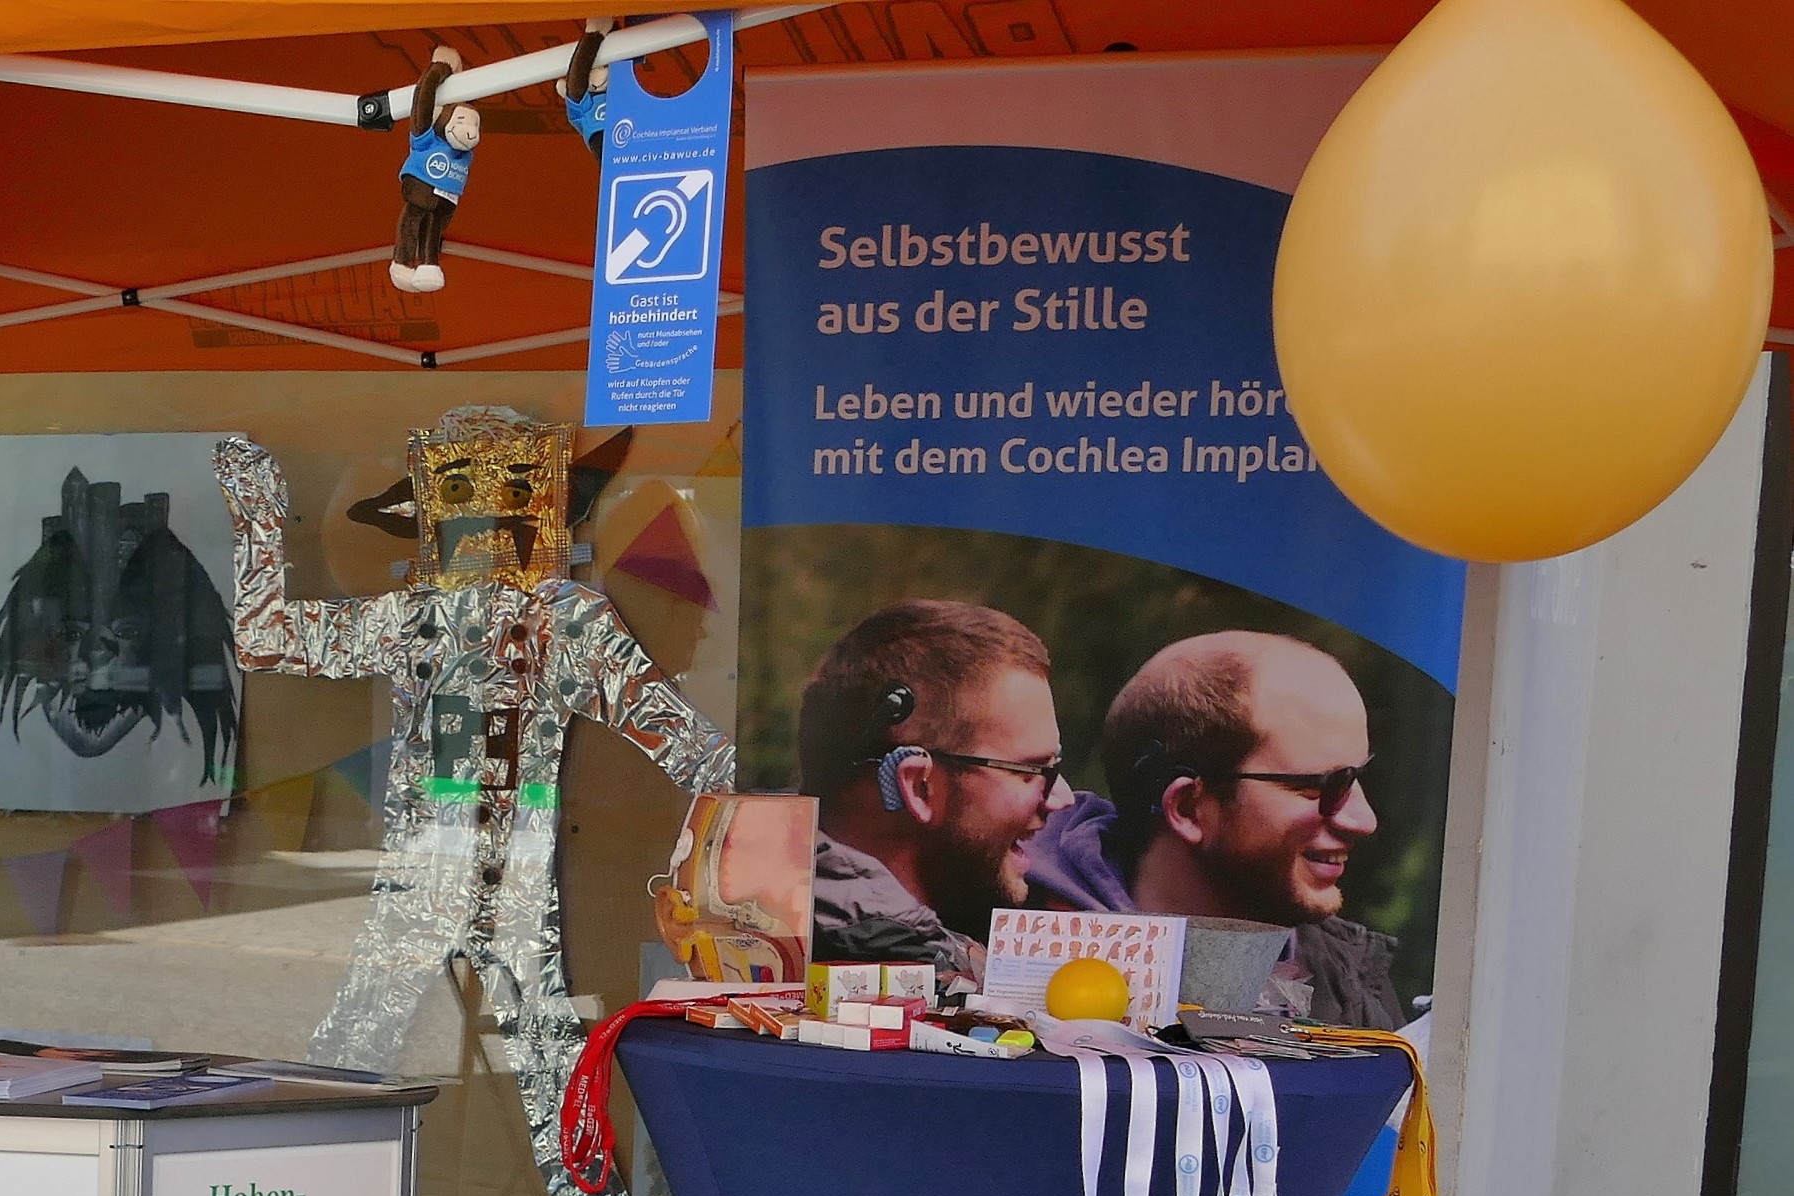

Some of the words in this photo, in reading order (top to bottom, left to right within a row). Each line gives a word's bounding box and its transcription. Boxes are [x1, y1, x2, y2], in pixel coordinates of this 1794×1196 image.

[613, 147, 716, 164] www.civ-bawue.de
[817, 222, 1191, 269] Selbstbewusst
[630, 295, 659, 308] Gast
[663, 293, 678, 305] ist
[609, 308, 698, 324] hörbehindert
[817, 300, 901, 334] aus
[915, 290, 999, 332] der
[1012, 287, 1148, 332] Stille
[635, 345, 698, 368] Gebärdensprache
[608, 380, 625, 388] wird
[626, 379, 639, 388] auf
[640, 377, 670, 388] Klopfen
[672, 377, 691, 385] oder
[611, 392, 634, 400] Rufen
[635, 391, 657, 400] durch
[659, 390, 671, 399] die
[673, 389, 685, 397] Tür
[814, 383, 942, 420] Leben
[953, 381, 1034, 419] und
[1046, 381, 1198, 418] wieder
[619, 404, 638, 412] nicht
[639, 402, 676, 412] reagieren
[813, 438, 883, 475] mit
[894, 438, 986, 475] dem
[999, 436, 1169, 474] Cochlea
